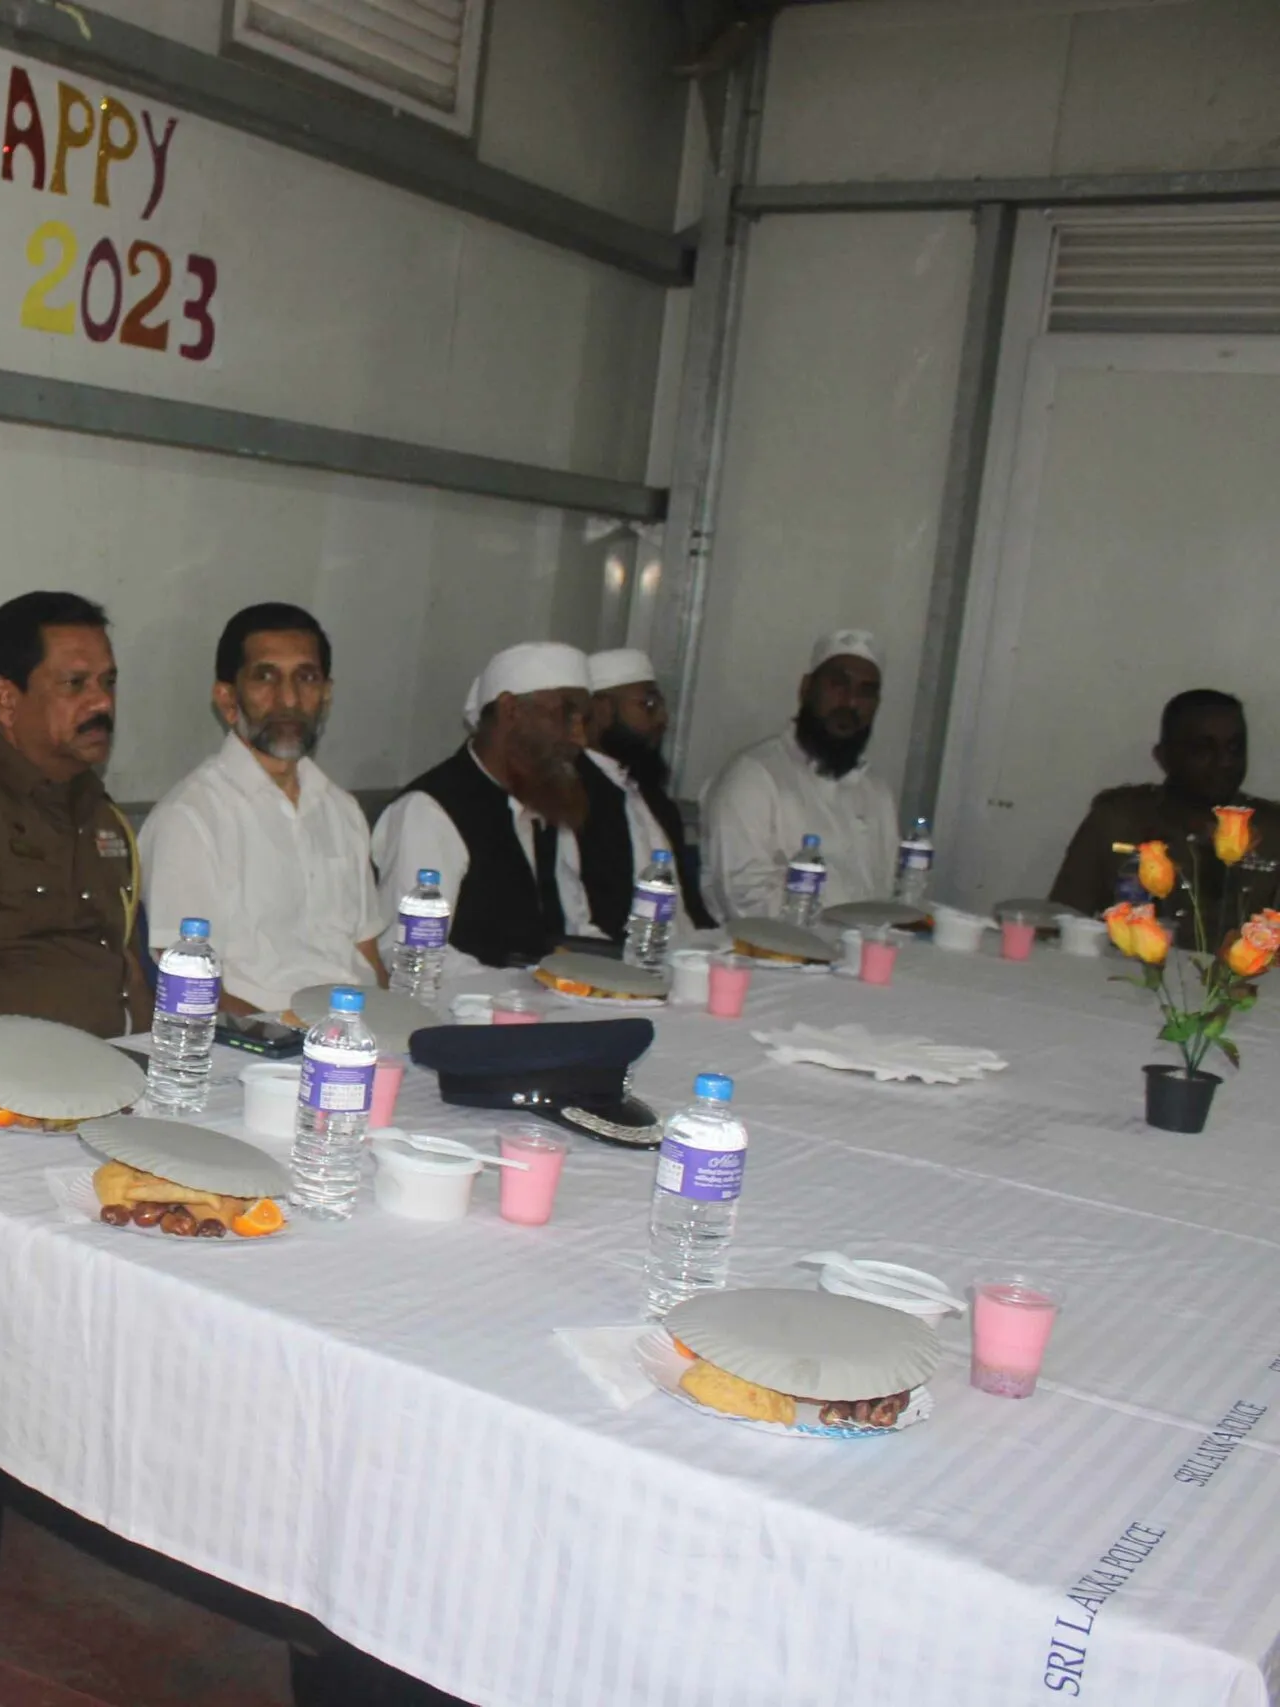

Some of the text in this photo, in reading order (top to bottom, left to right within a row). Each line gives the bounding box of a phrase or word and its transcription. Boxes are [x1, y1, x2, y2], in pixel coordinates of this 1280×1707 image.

[21, 219, 218, 361] 2023
[1173, 1400, 1267, 1487] SRI LANKA POLICE
[1043, 1521, 1167, 1698] SRI LANKA POLICE
